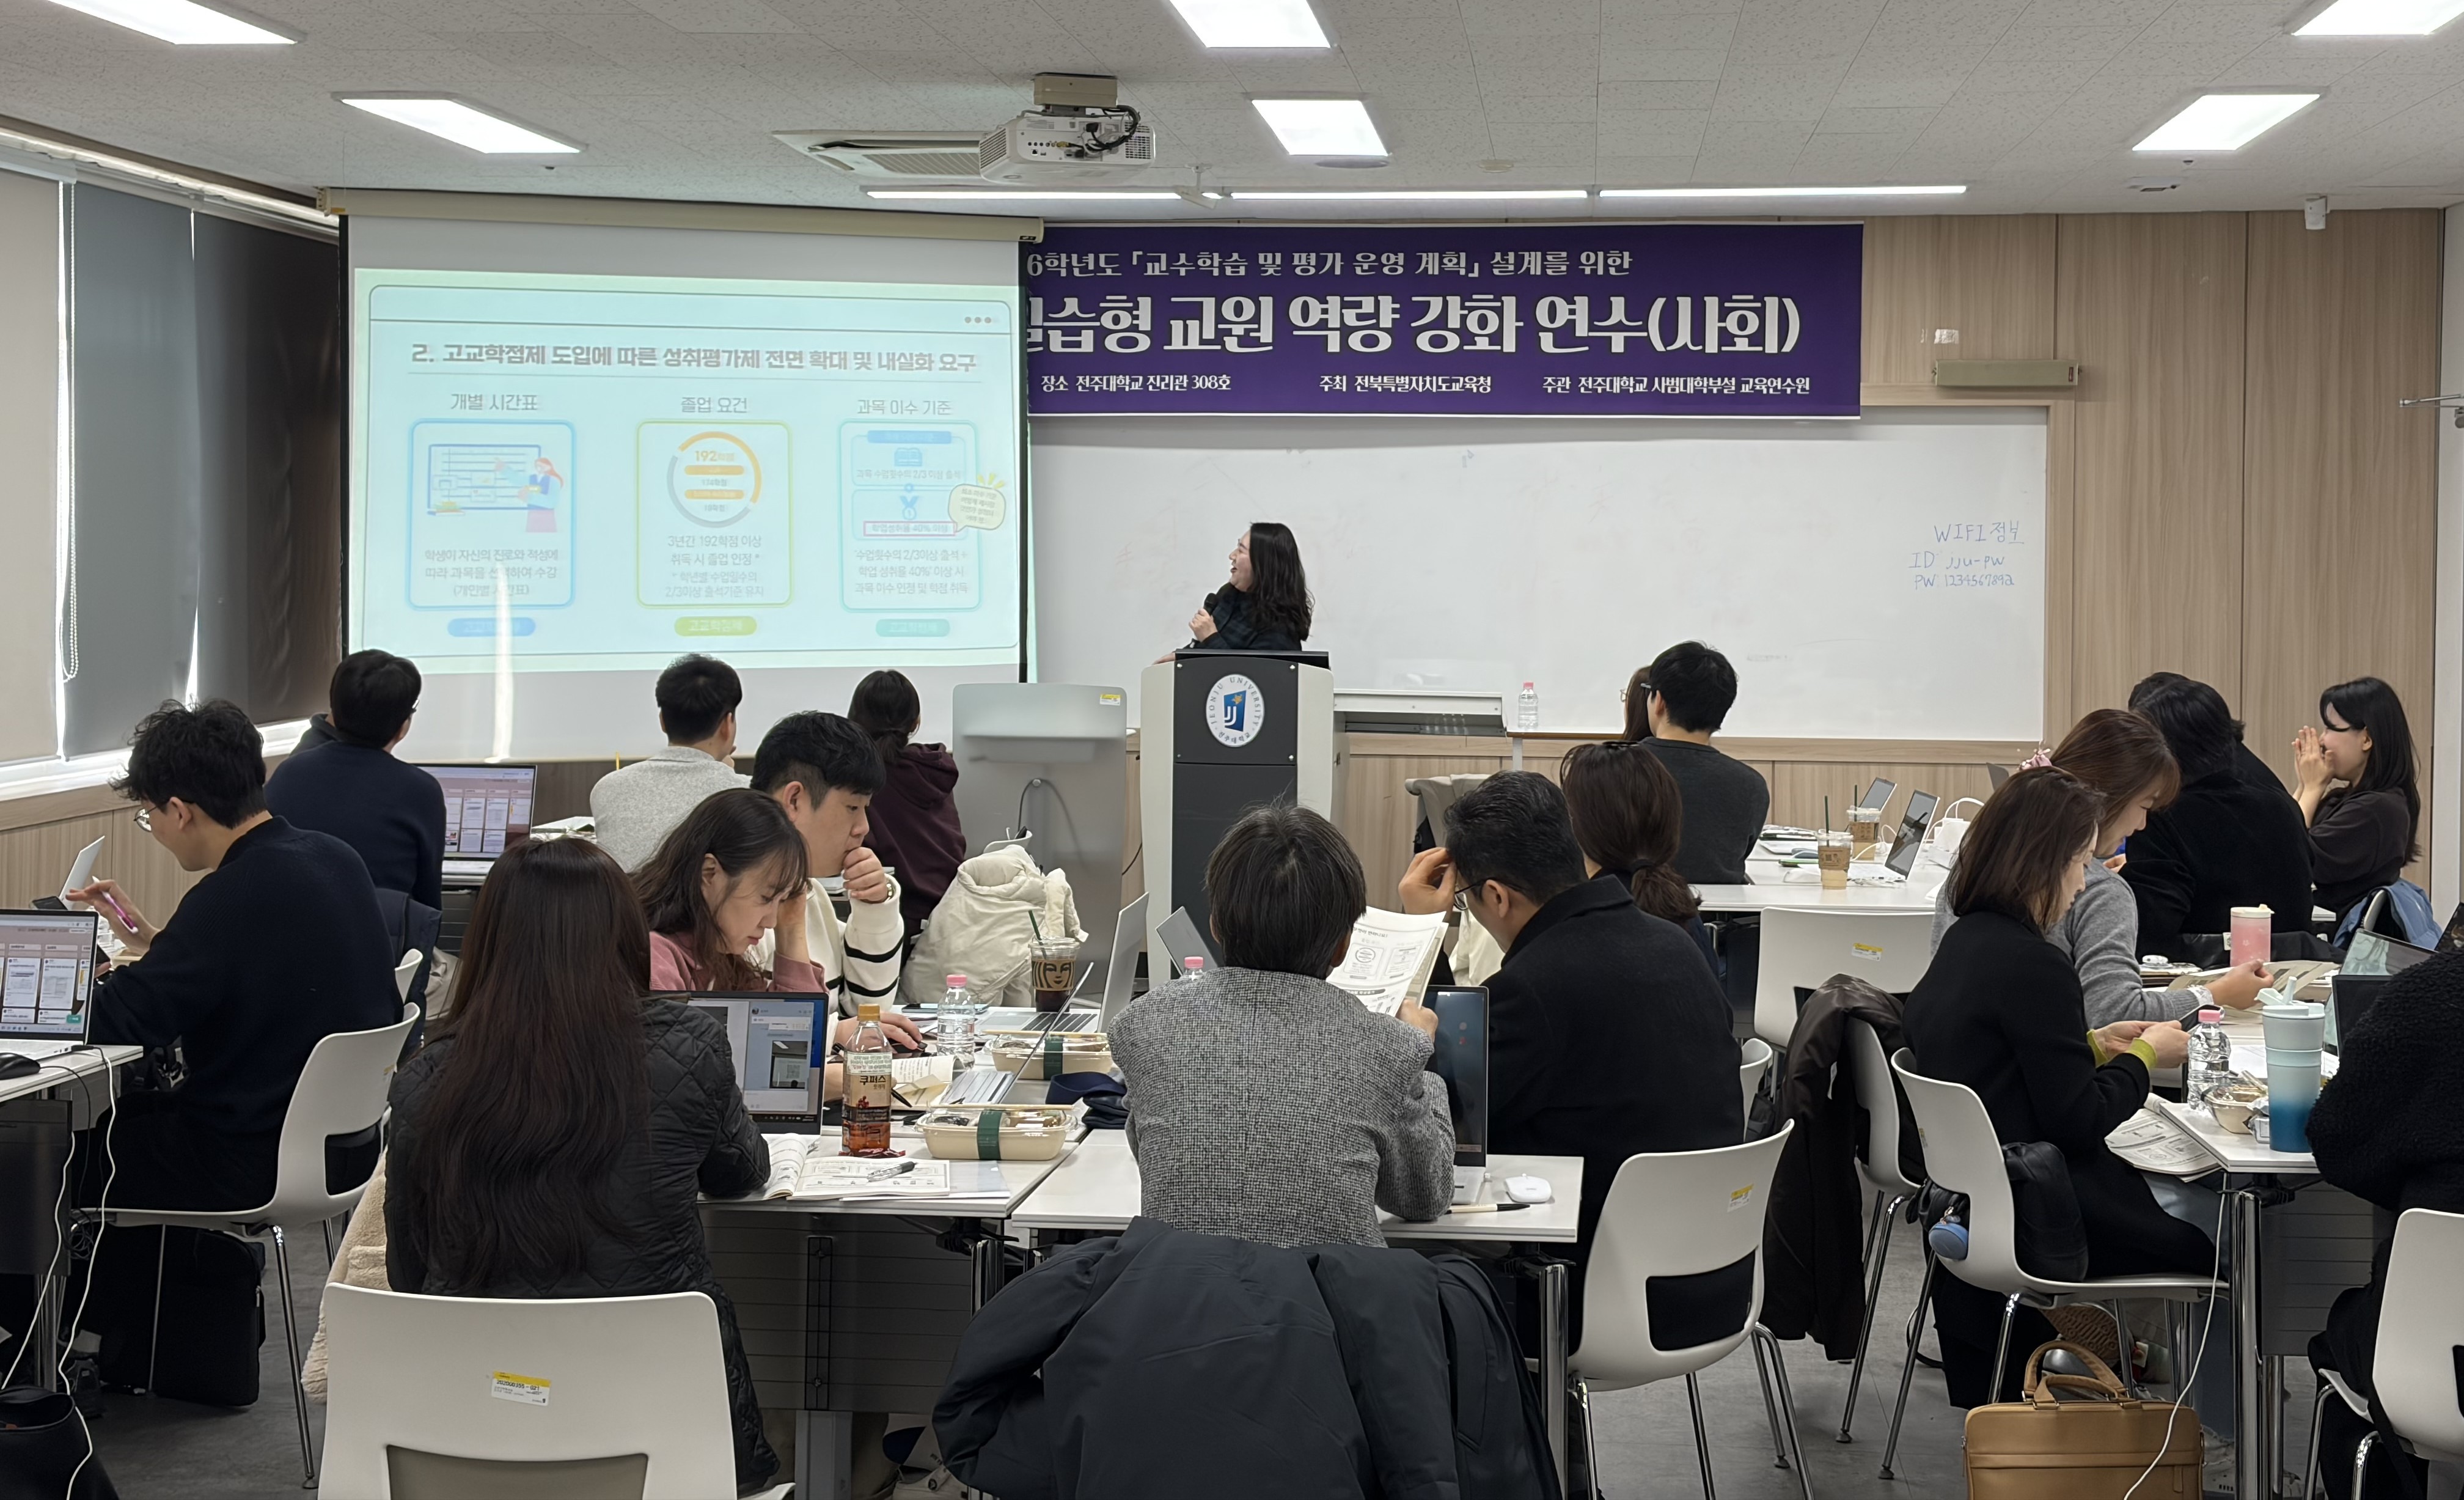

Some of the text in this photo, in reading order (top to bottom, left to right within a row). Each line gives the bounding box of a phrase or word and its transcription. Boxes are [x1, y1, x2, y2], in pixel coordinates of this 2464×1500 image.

[1258, 252, 1282, 276] 및
[1291, 252, 1344, 276] 평가
[1353, 252, 1404, 275] 운영
[1414, 251, 1479, 278] 계획」
[1490, 251, 1569, 276] 설계를
[1578, 251, 1633, 276] 위한
[1163, 296, 1273, 353] 교원
[1288, 295, 1401, 353] 역량
[1410, 295, 1524, 353] 강화
[1535, 295, 1800, 353] 연수(사회)
[412, 344, 976, 373] 2. 고교학점제 도입에 따른 성취평가제 전면 확대 및 내실화 요구
[1041, 374, 1231, 392] 장소 전주대학교 진리관 308호
[1319, 375, 1491, 394] 주최 전북특별자치도교육청
[1542, 376, 1810, 394] 주관 전주대학교 사범대학부설 교육연수원
[450, 393, 538, 411] 개별 시간표
[681, 397, 747, 414] 졸업 요건
[857, 399, 952, 416] 과목 이수 기준
[1934, 520, 2025, 545] WIFI 정보
[667, 535, 761, 548] 3년간 192학점 이상
[425, 549, 559, 562] 학생이 자신의 진로와 적성에
[670, 553, 752, 566] 취득 시 졸업 인정
[425, 567, 448, 579] 따라
[450, 567, 485, 579] 과목을
[535, 566, 557, 578] 수강
[934, 566, 952, 578] 이상
[1209, 676, 1262, 727] JEONJU UNIVERSITY
[1218, 732, 1251, 744] 전주대학교
[859, 1075, 886, 1086] 쿠퍼스
